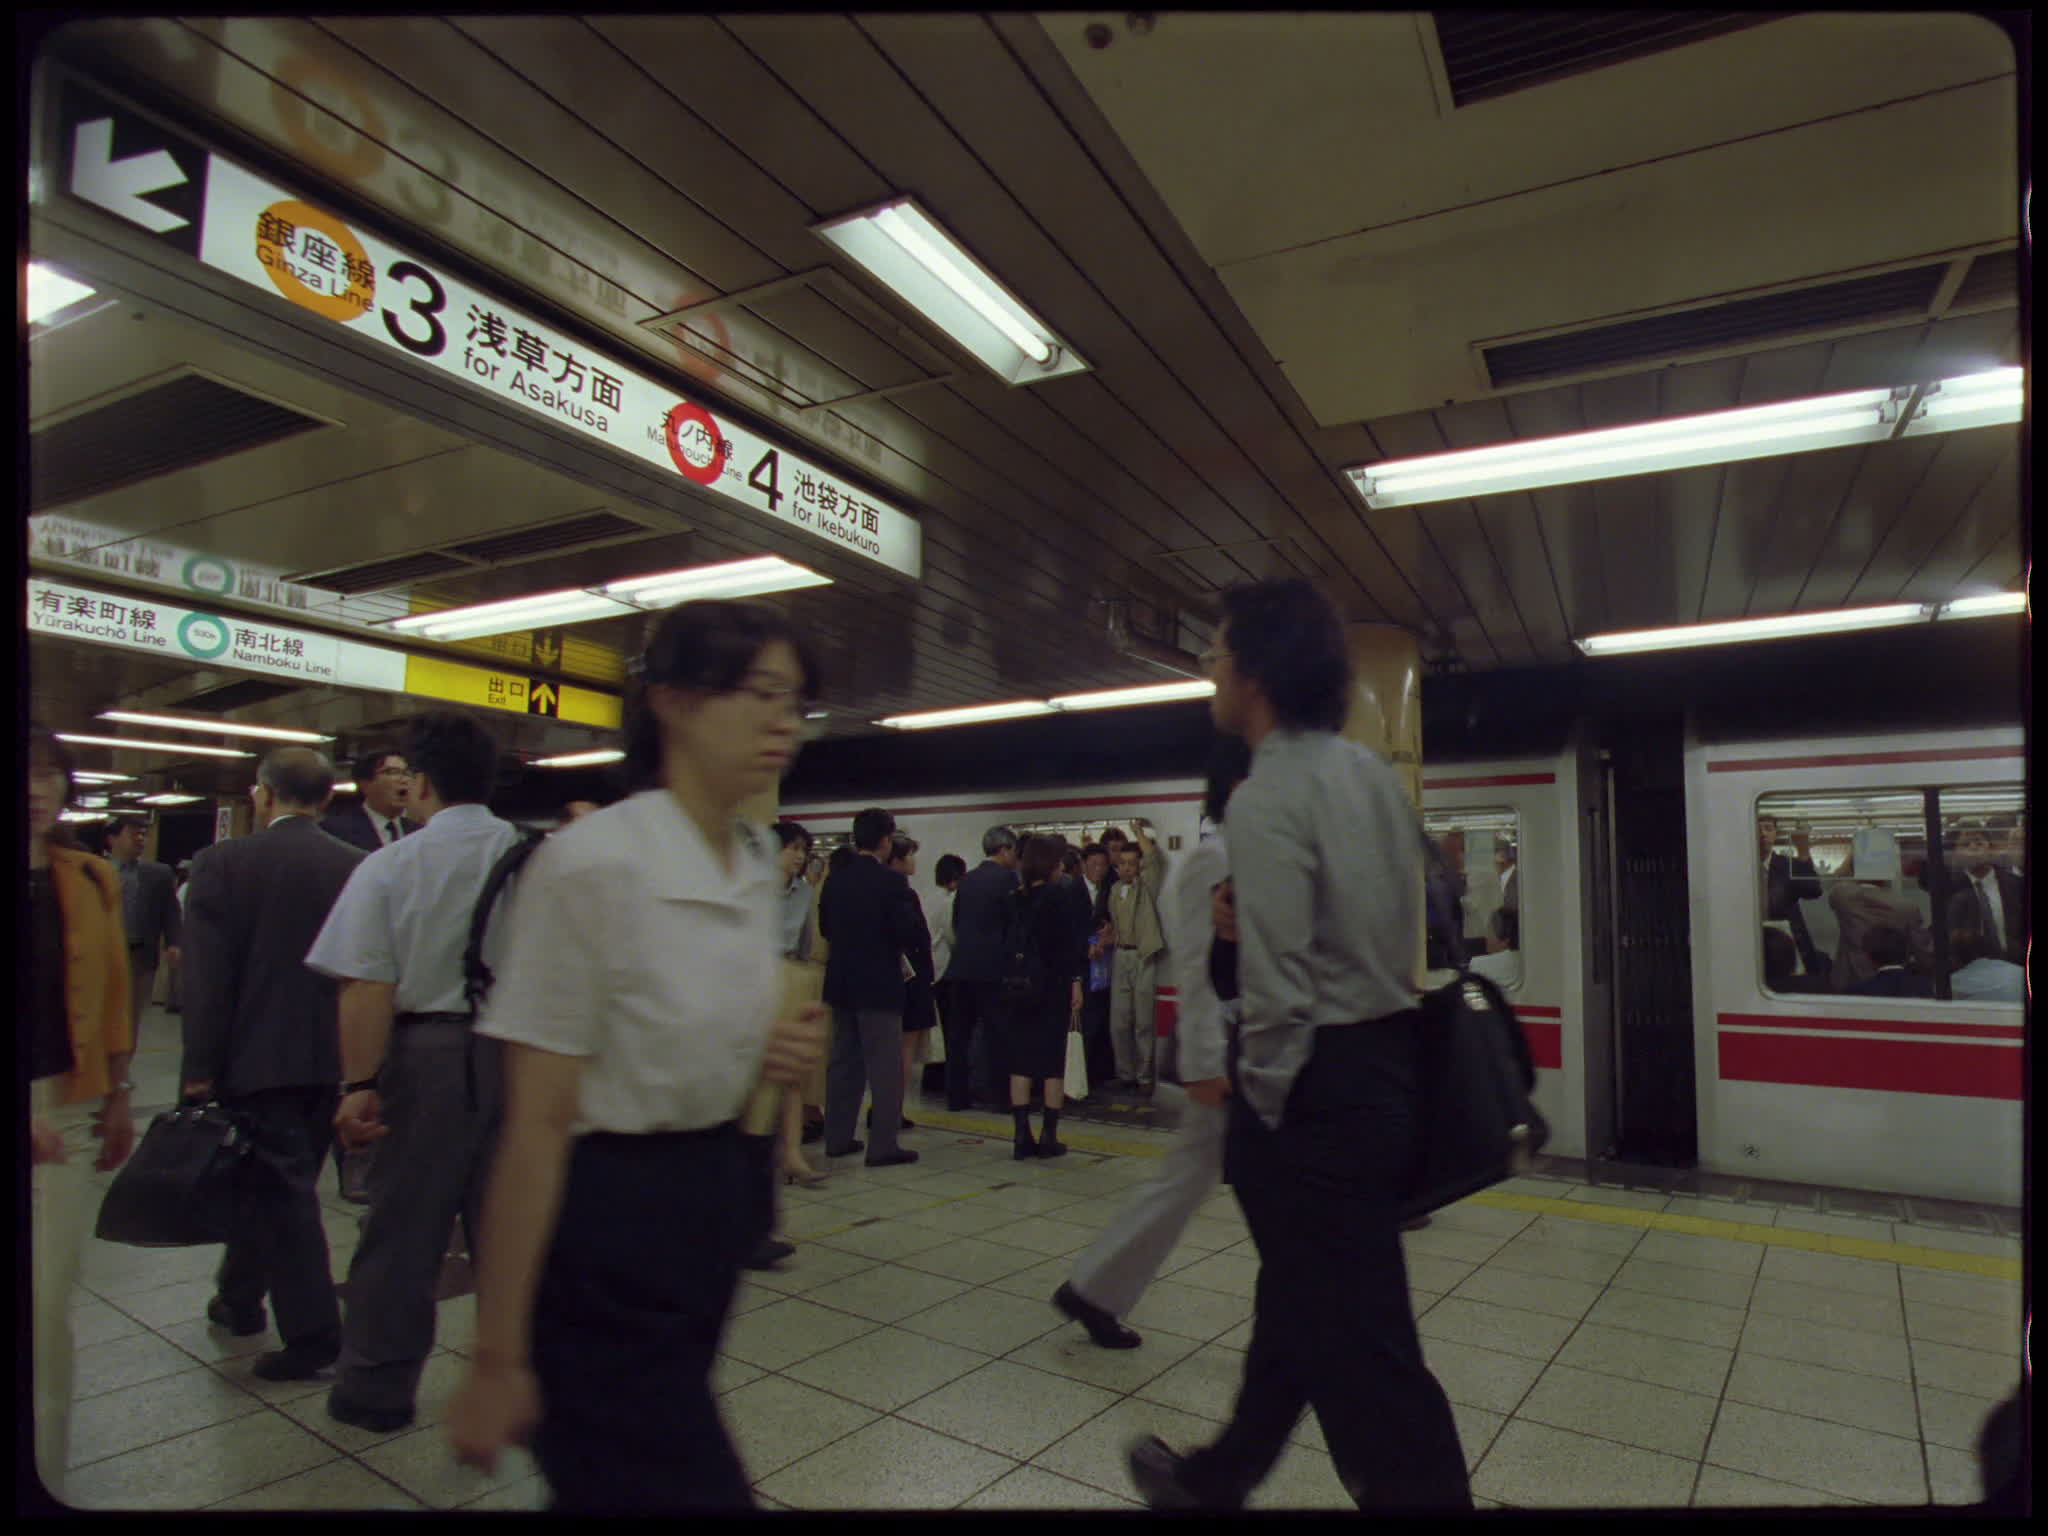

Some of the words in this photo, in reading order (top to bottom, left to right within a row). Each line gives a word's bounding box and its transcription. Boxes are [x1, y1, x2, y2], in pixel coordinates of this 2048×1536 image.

[257, 211, 376, 290] 銀座線
[257, 245, 322, 289] Ginza
[331, 278, 374, 312] Line
[382, 261, 447, 357] 3
[466, 304, 624, 413] 浅草方面
[464, 347, 500, 380] for
[509, 370, 608, 433] Asakusa
[660, 409, 734, 461] 丸ノ内線
[748, 448, 783, 512] 4
[794, 469, 880, 536] 池袋方面
[792, 500, 812, 523] for
[818, 512, 880, 555] Ikebukuro
[34, 590, 157, 630] 有楽町線
[134, 629, 167, 646] Line
[233, 648, 300, 670] Namboku
[305, 661, 332, 676] Line
[235, 629, 304, 657] 南北線
[488, 693, 506, 705] Exit
[489, 676, 524, 696] 出口
